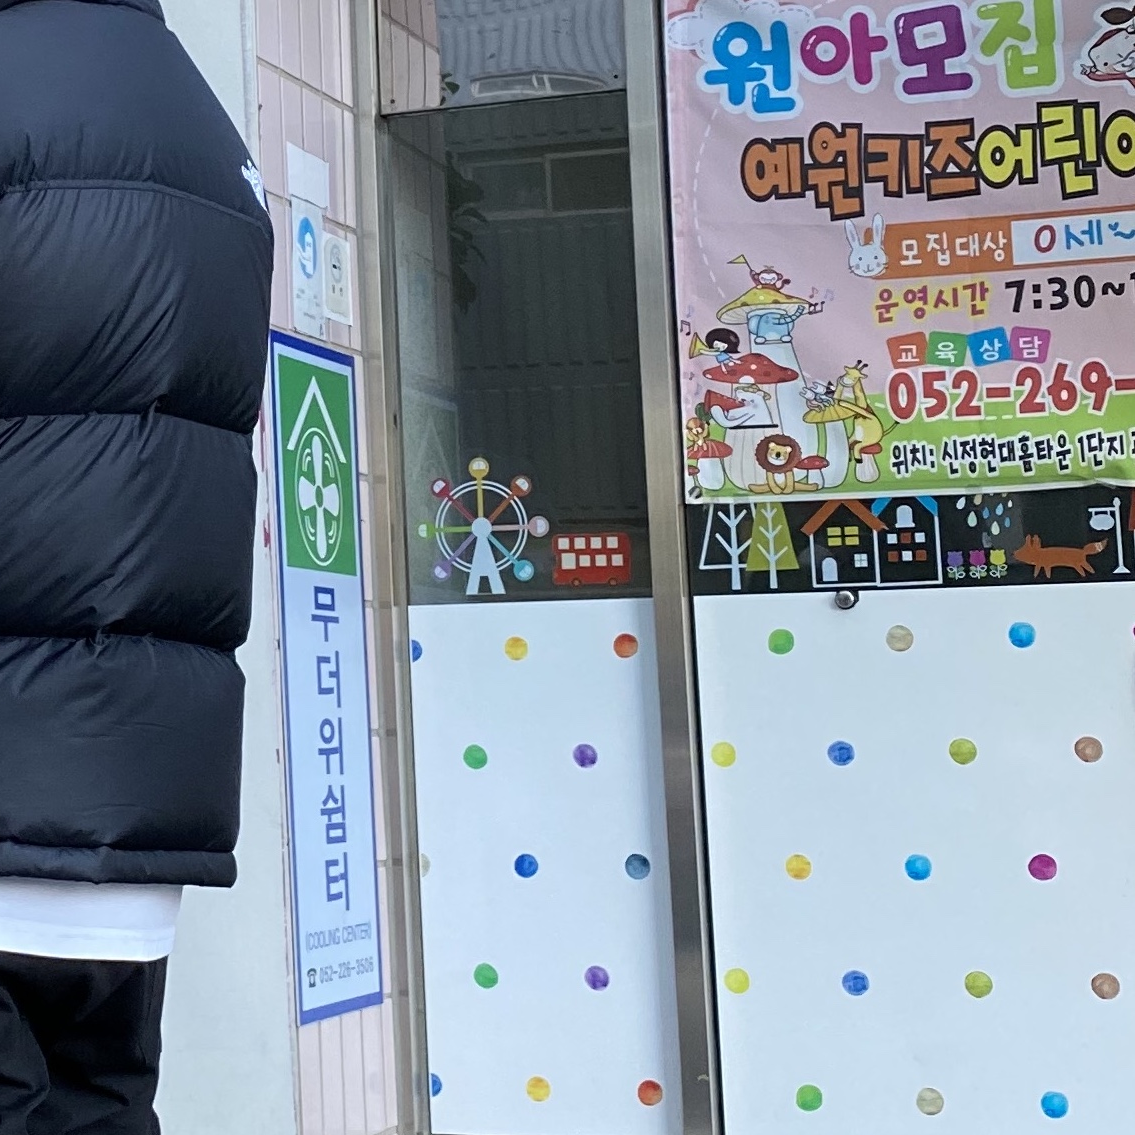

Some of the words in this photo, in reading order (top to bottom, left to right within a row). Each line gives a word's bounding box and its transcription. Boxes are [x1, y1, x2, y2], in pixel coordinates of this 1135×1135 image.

[704, 0, 1056, 114] 원아모집
[900, 230, 1007, 266] 모집대상
[875, 281, 989, 323] 운영시간
[1004, 271, 1135, 313] 7:30~
[898, 335, 1043, 363] 교육상담
[888, 360, 1135, 421] 052-269-
[942, 433, 1071, 475] 신정현대홈타운
[1077, 431, 1125, 467] 1단지
[311, 585, 351, 911] 무더위쉼터
[305, 928, 340, 954] (COOLING
